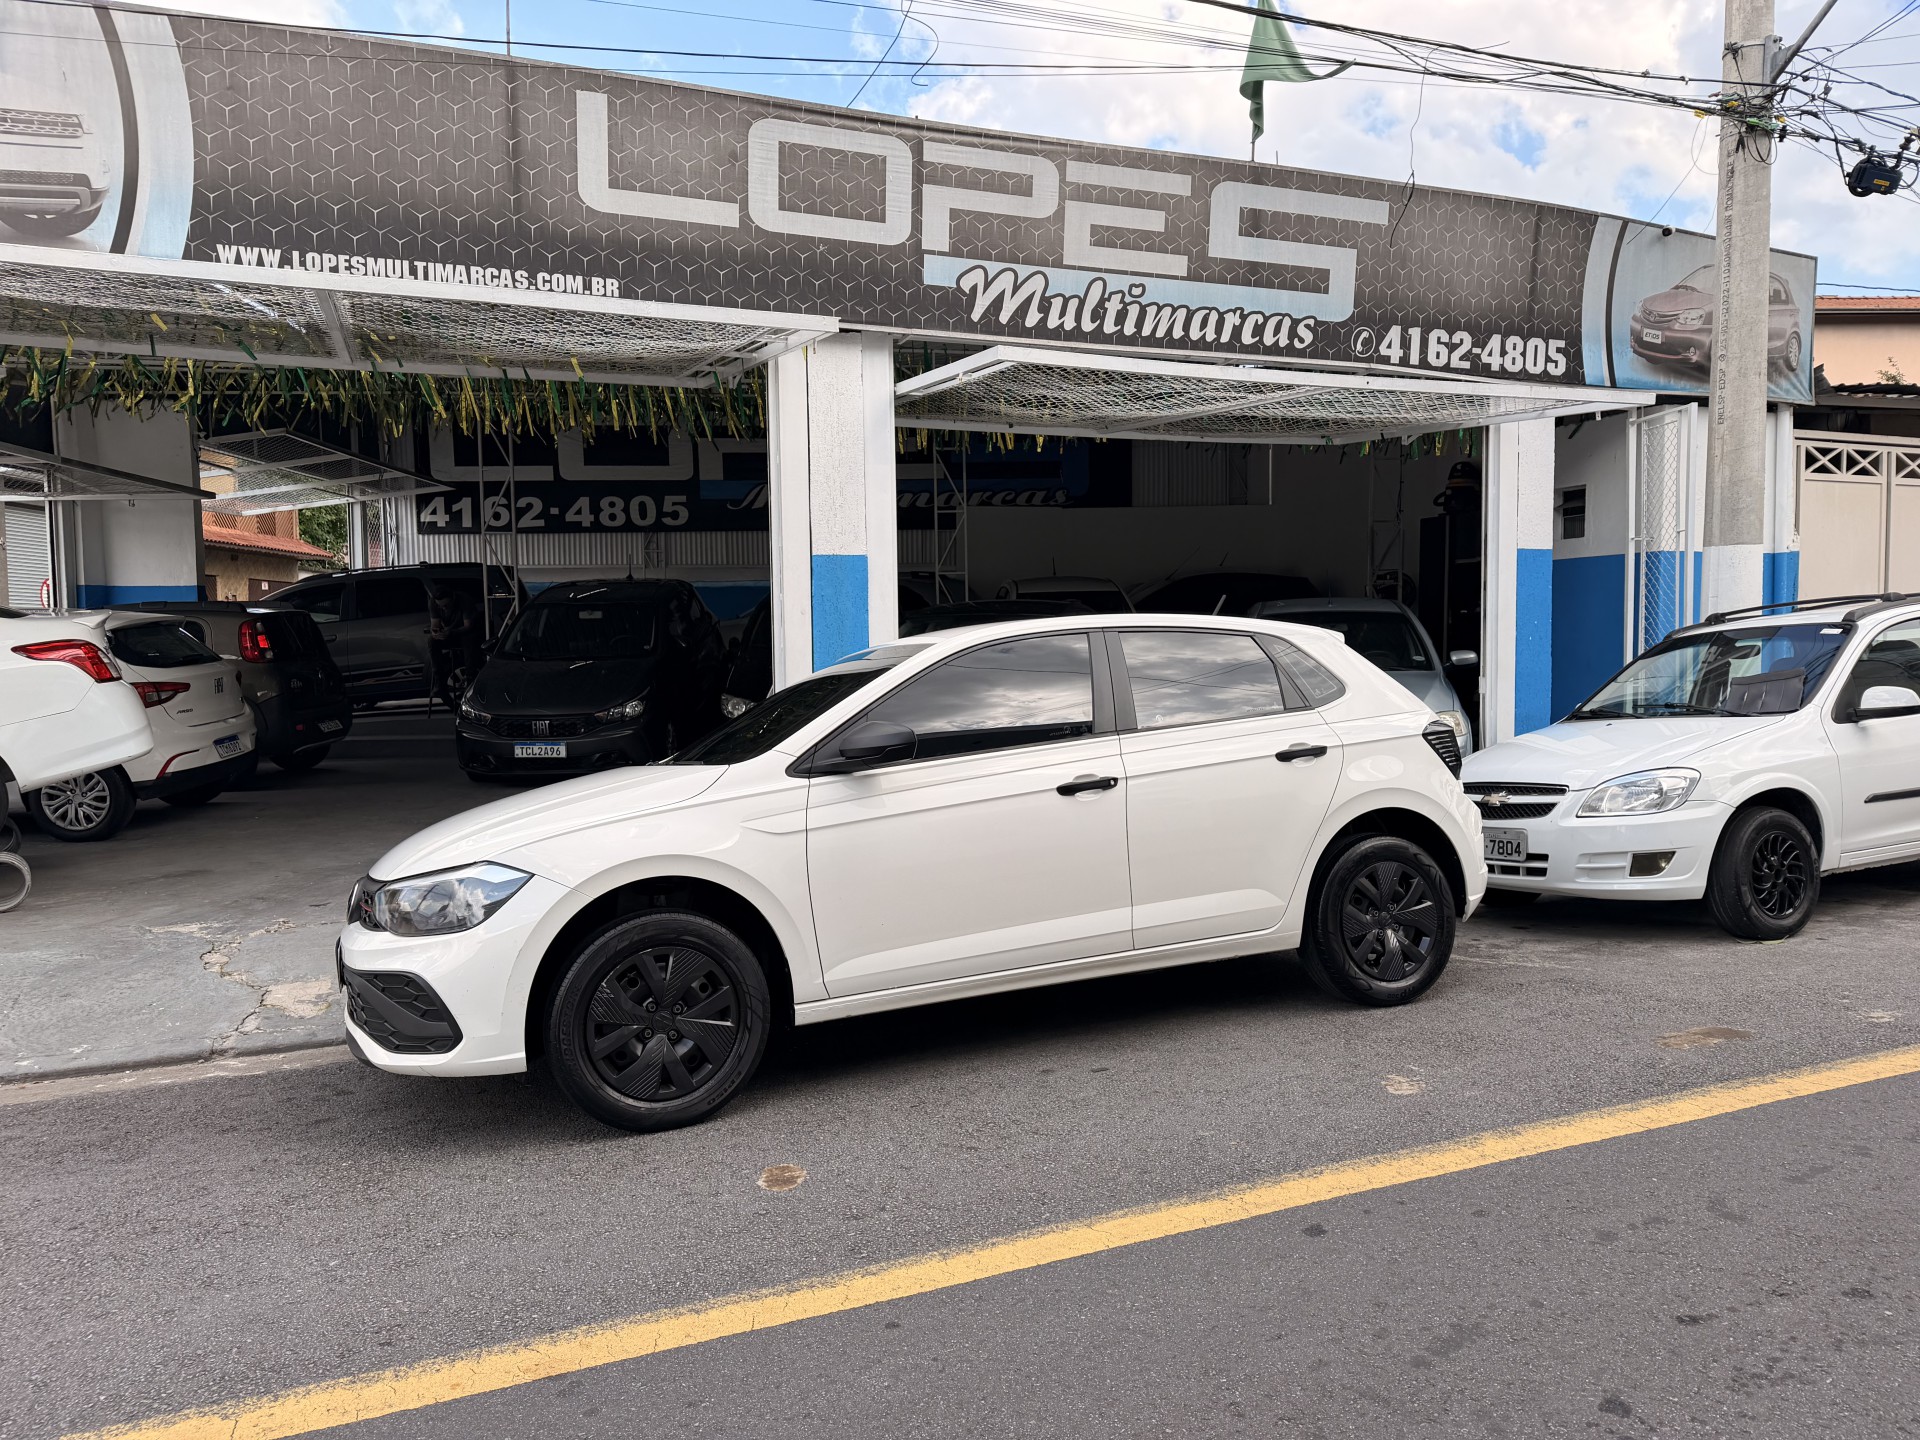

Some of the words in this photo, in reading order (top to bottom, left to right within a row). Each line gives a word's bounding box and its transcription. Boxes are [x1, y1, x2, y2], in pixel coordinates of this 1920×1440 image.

[576, 90, 1390, 322] LOPES
[216, 244, 620, 298] WWW.LOPESMULTIMARCAS.COM.BR
[959, 268, 1316, 351] Multimarcas
[1378, 324, 1567, 376] 4162-4805
[520, 746, 561, 756] TCL2A96
[531, 720, 550, 736] FIAT
